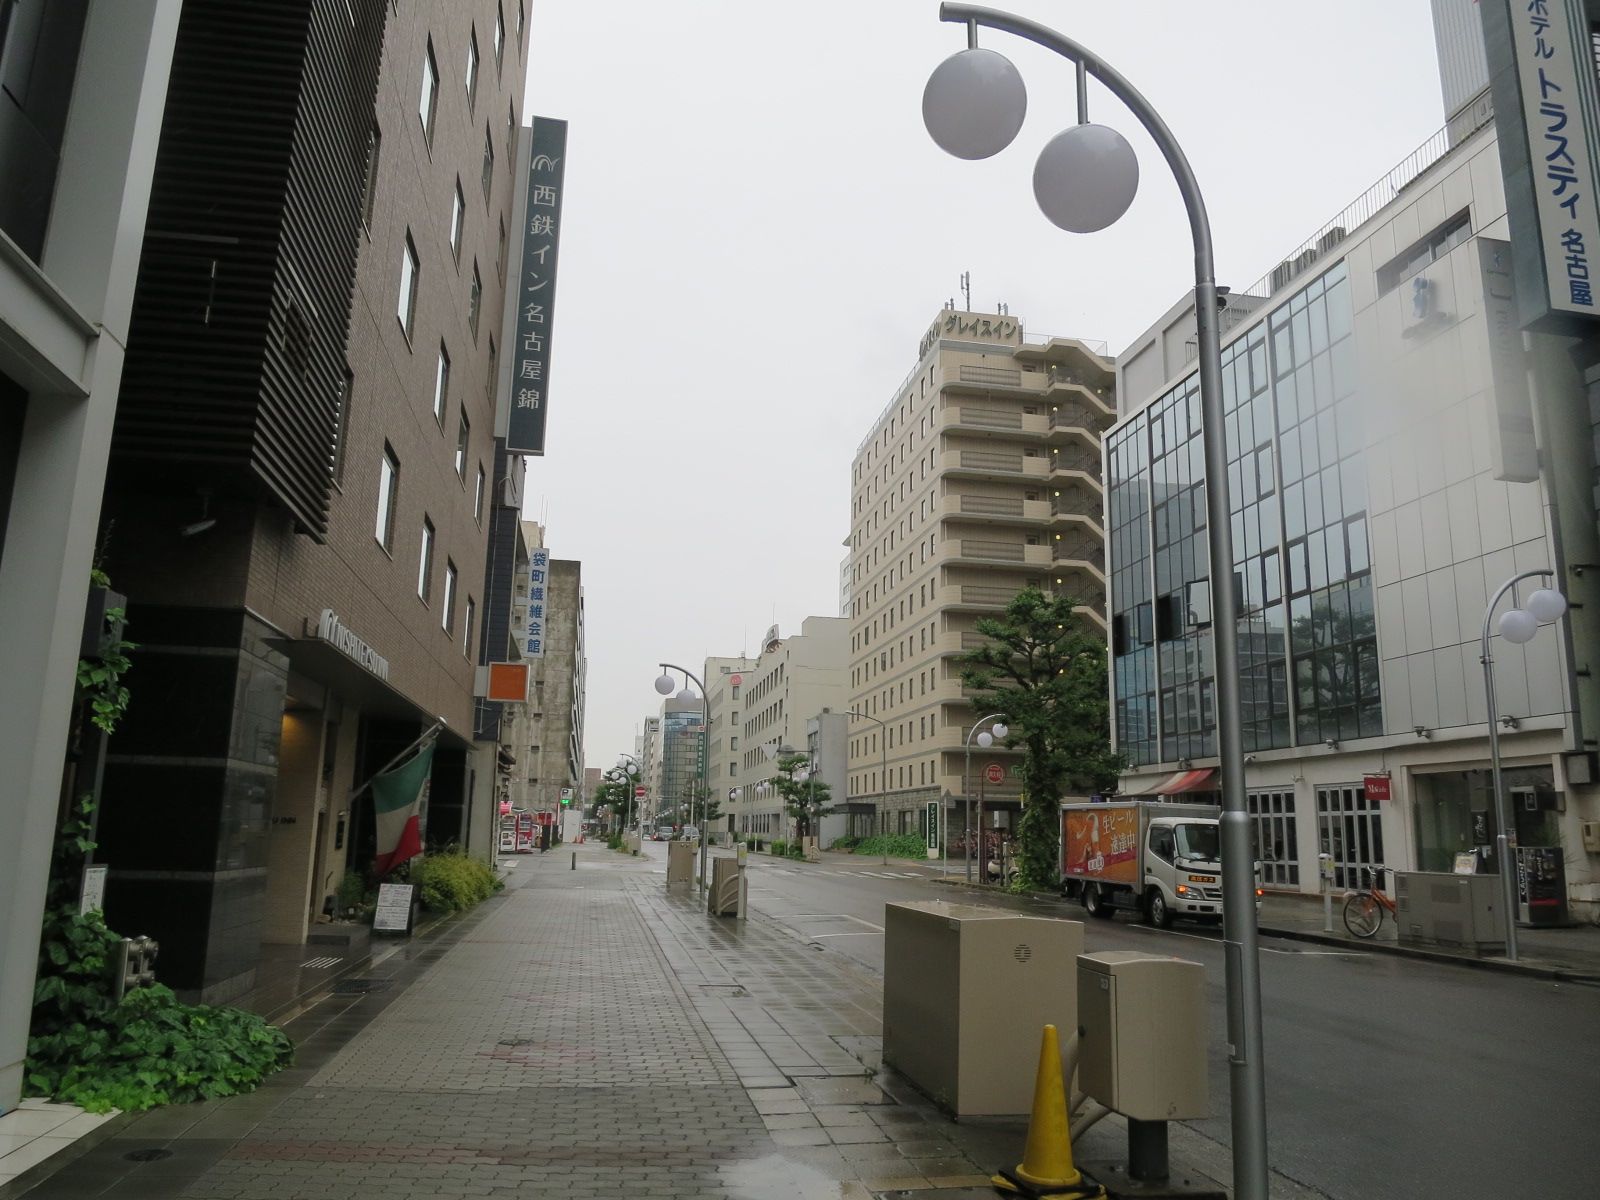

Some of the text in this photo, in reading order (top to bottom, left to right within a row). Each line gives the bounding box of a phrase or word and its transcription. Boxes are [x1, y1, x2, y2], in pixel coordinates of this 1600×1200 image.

[517, 184, 556, 410] 西鉄イン名古屋錦
[1561, 228, 1594, 307] 名古屋
[944, 314, 1016, 339] グレイスイン
